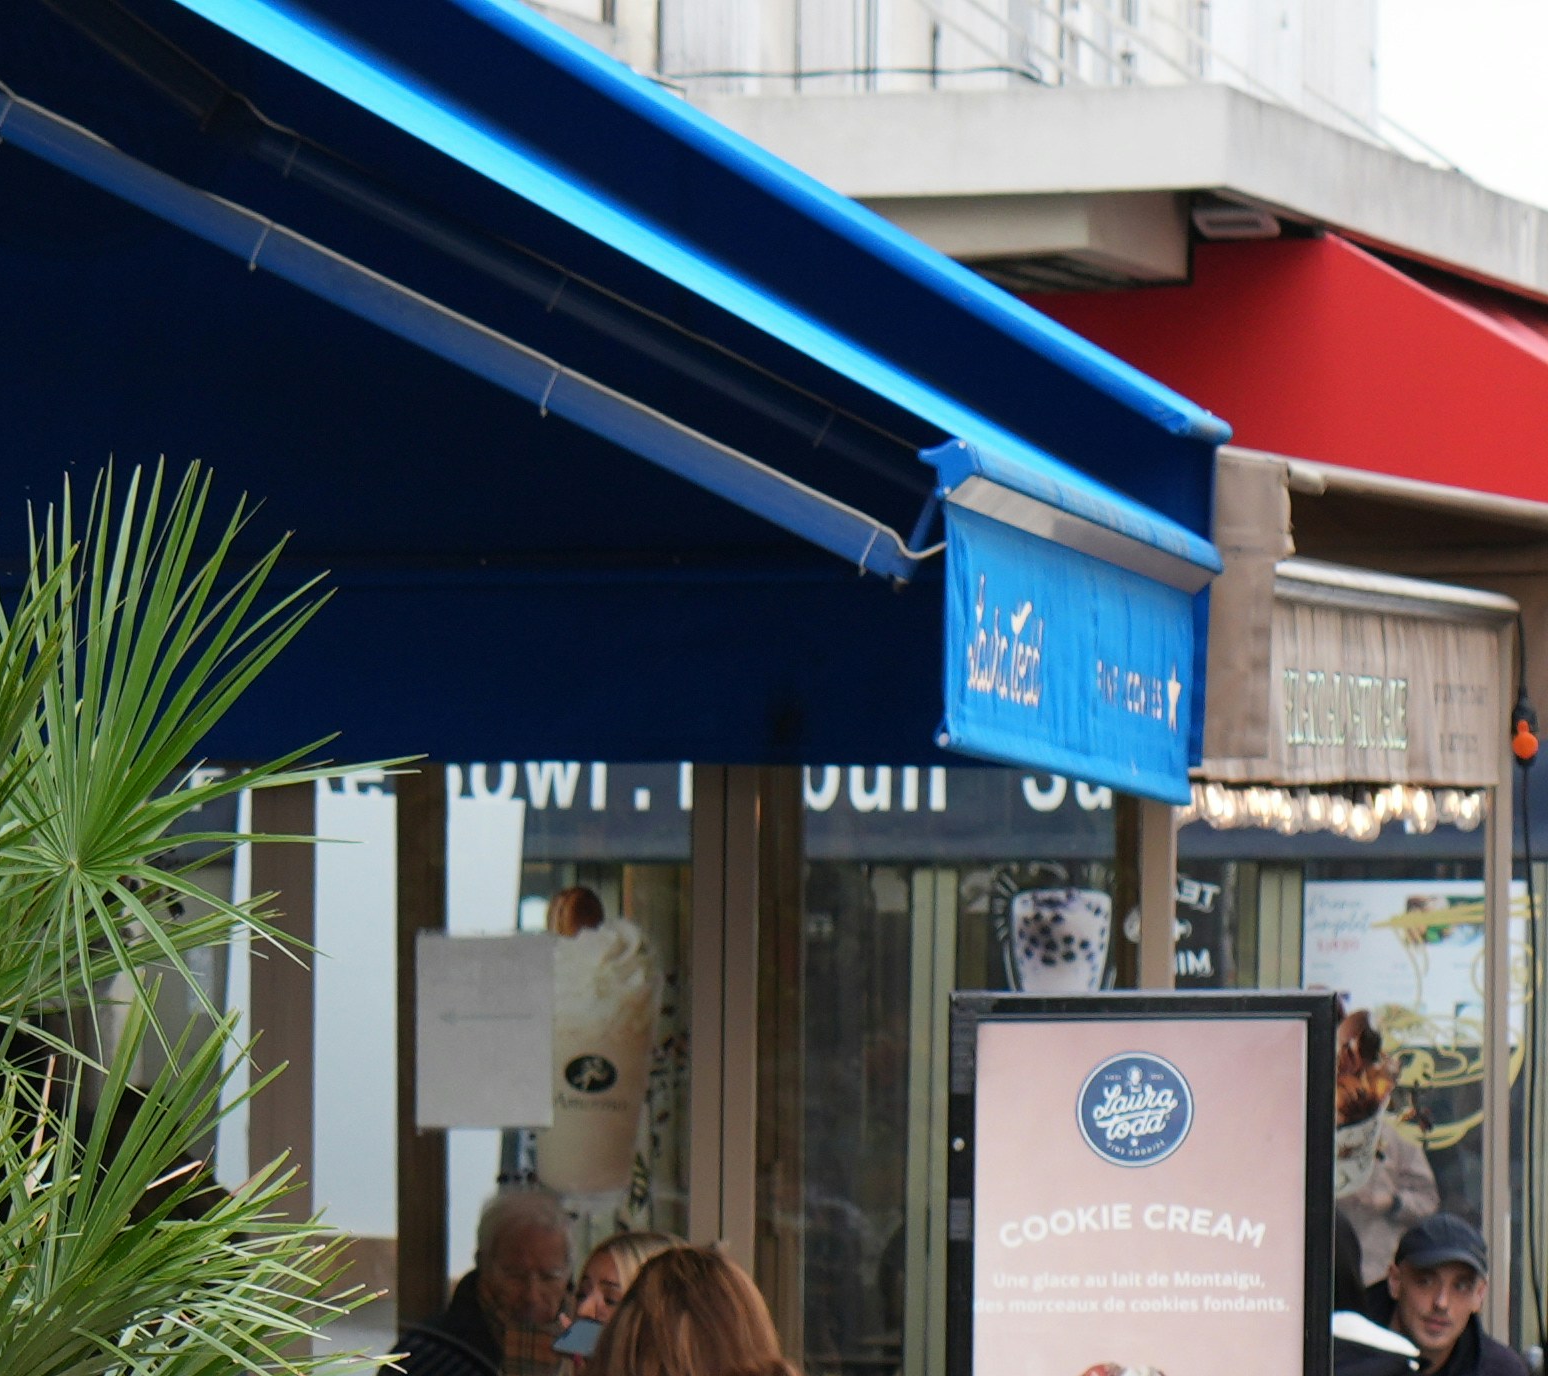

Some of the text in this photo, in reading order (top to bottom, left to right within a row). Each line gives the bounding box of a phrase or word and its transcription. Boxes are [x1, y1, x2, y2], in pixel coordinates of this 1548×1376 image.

[1093, 1084, 1178, 1119] Laura
[999, 1203, 1266, 1249] COOKIE CREAM
[993, 1271, 1266, 1292] Une glace au lait de Montaigu,
[1010, 1299, 1098, 1313] morceaux
[1103, 1296, 1126, 1313] de
[1130, 1296, 1198, 1313] cookies
[1203, 1296, 1290, 1313] fondants.
